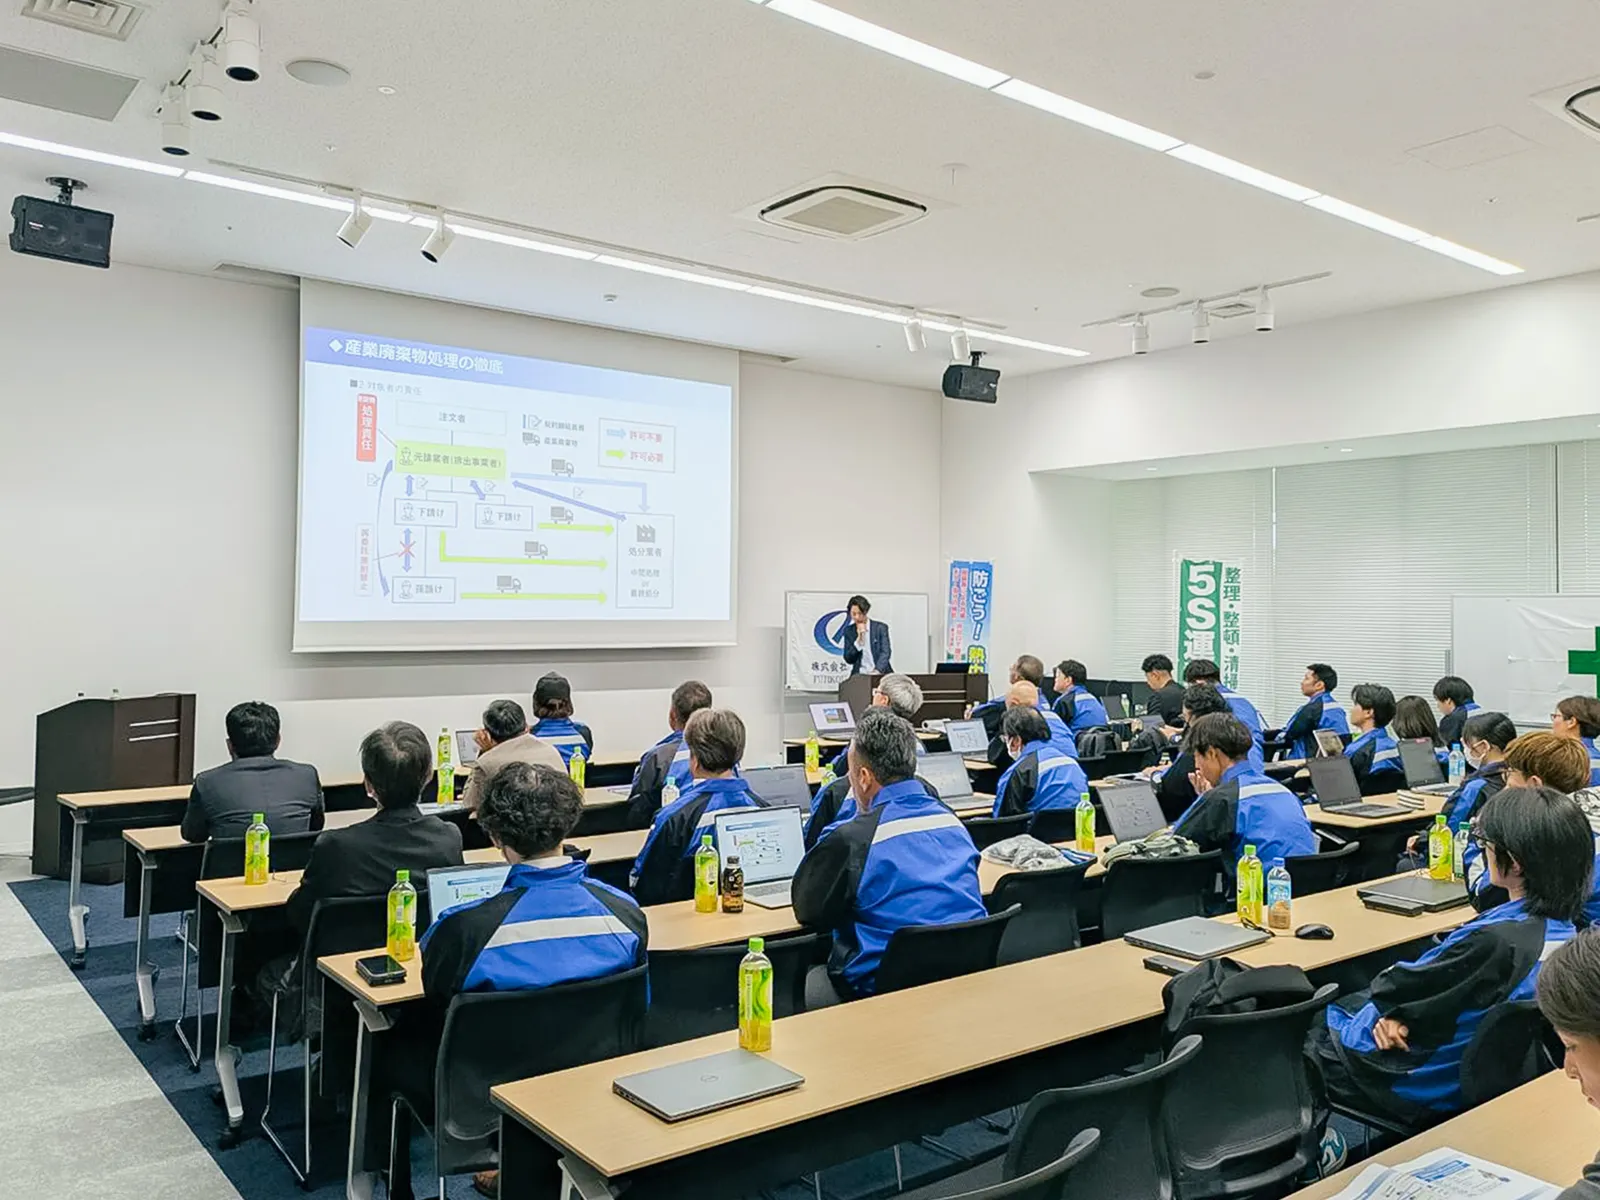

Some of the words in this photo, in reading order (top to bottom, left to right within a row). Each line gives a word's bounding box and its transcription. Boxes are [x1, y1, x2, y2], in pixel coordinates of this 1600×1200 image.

[344, 339, 504, 374] 産業廃棄物処理の徹底
[438, 411, 466, 424] 注文者
[418, 507, 445, 518] 下請け
[497, 511, 522, 523] 下請け
[628, 547, 662, 558] 処分業者
[811, 660, 847, 673] 株式会社
